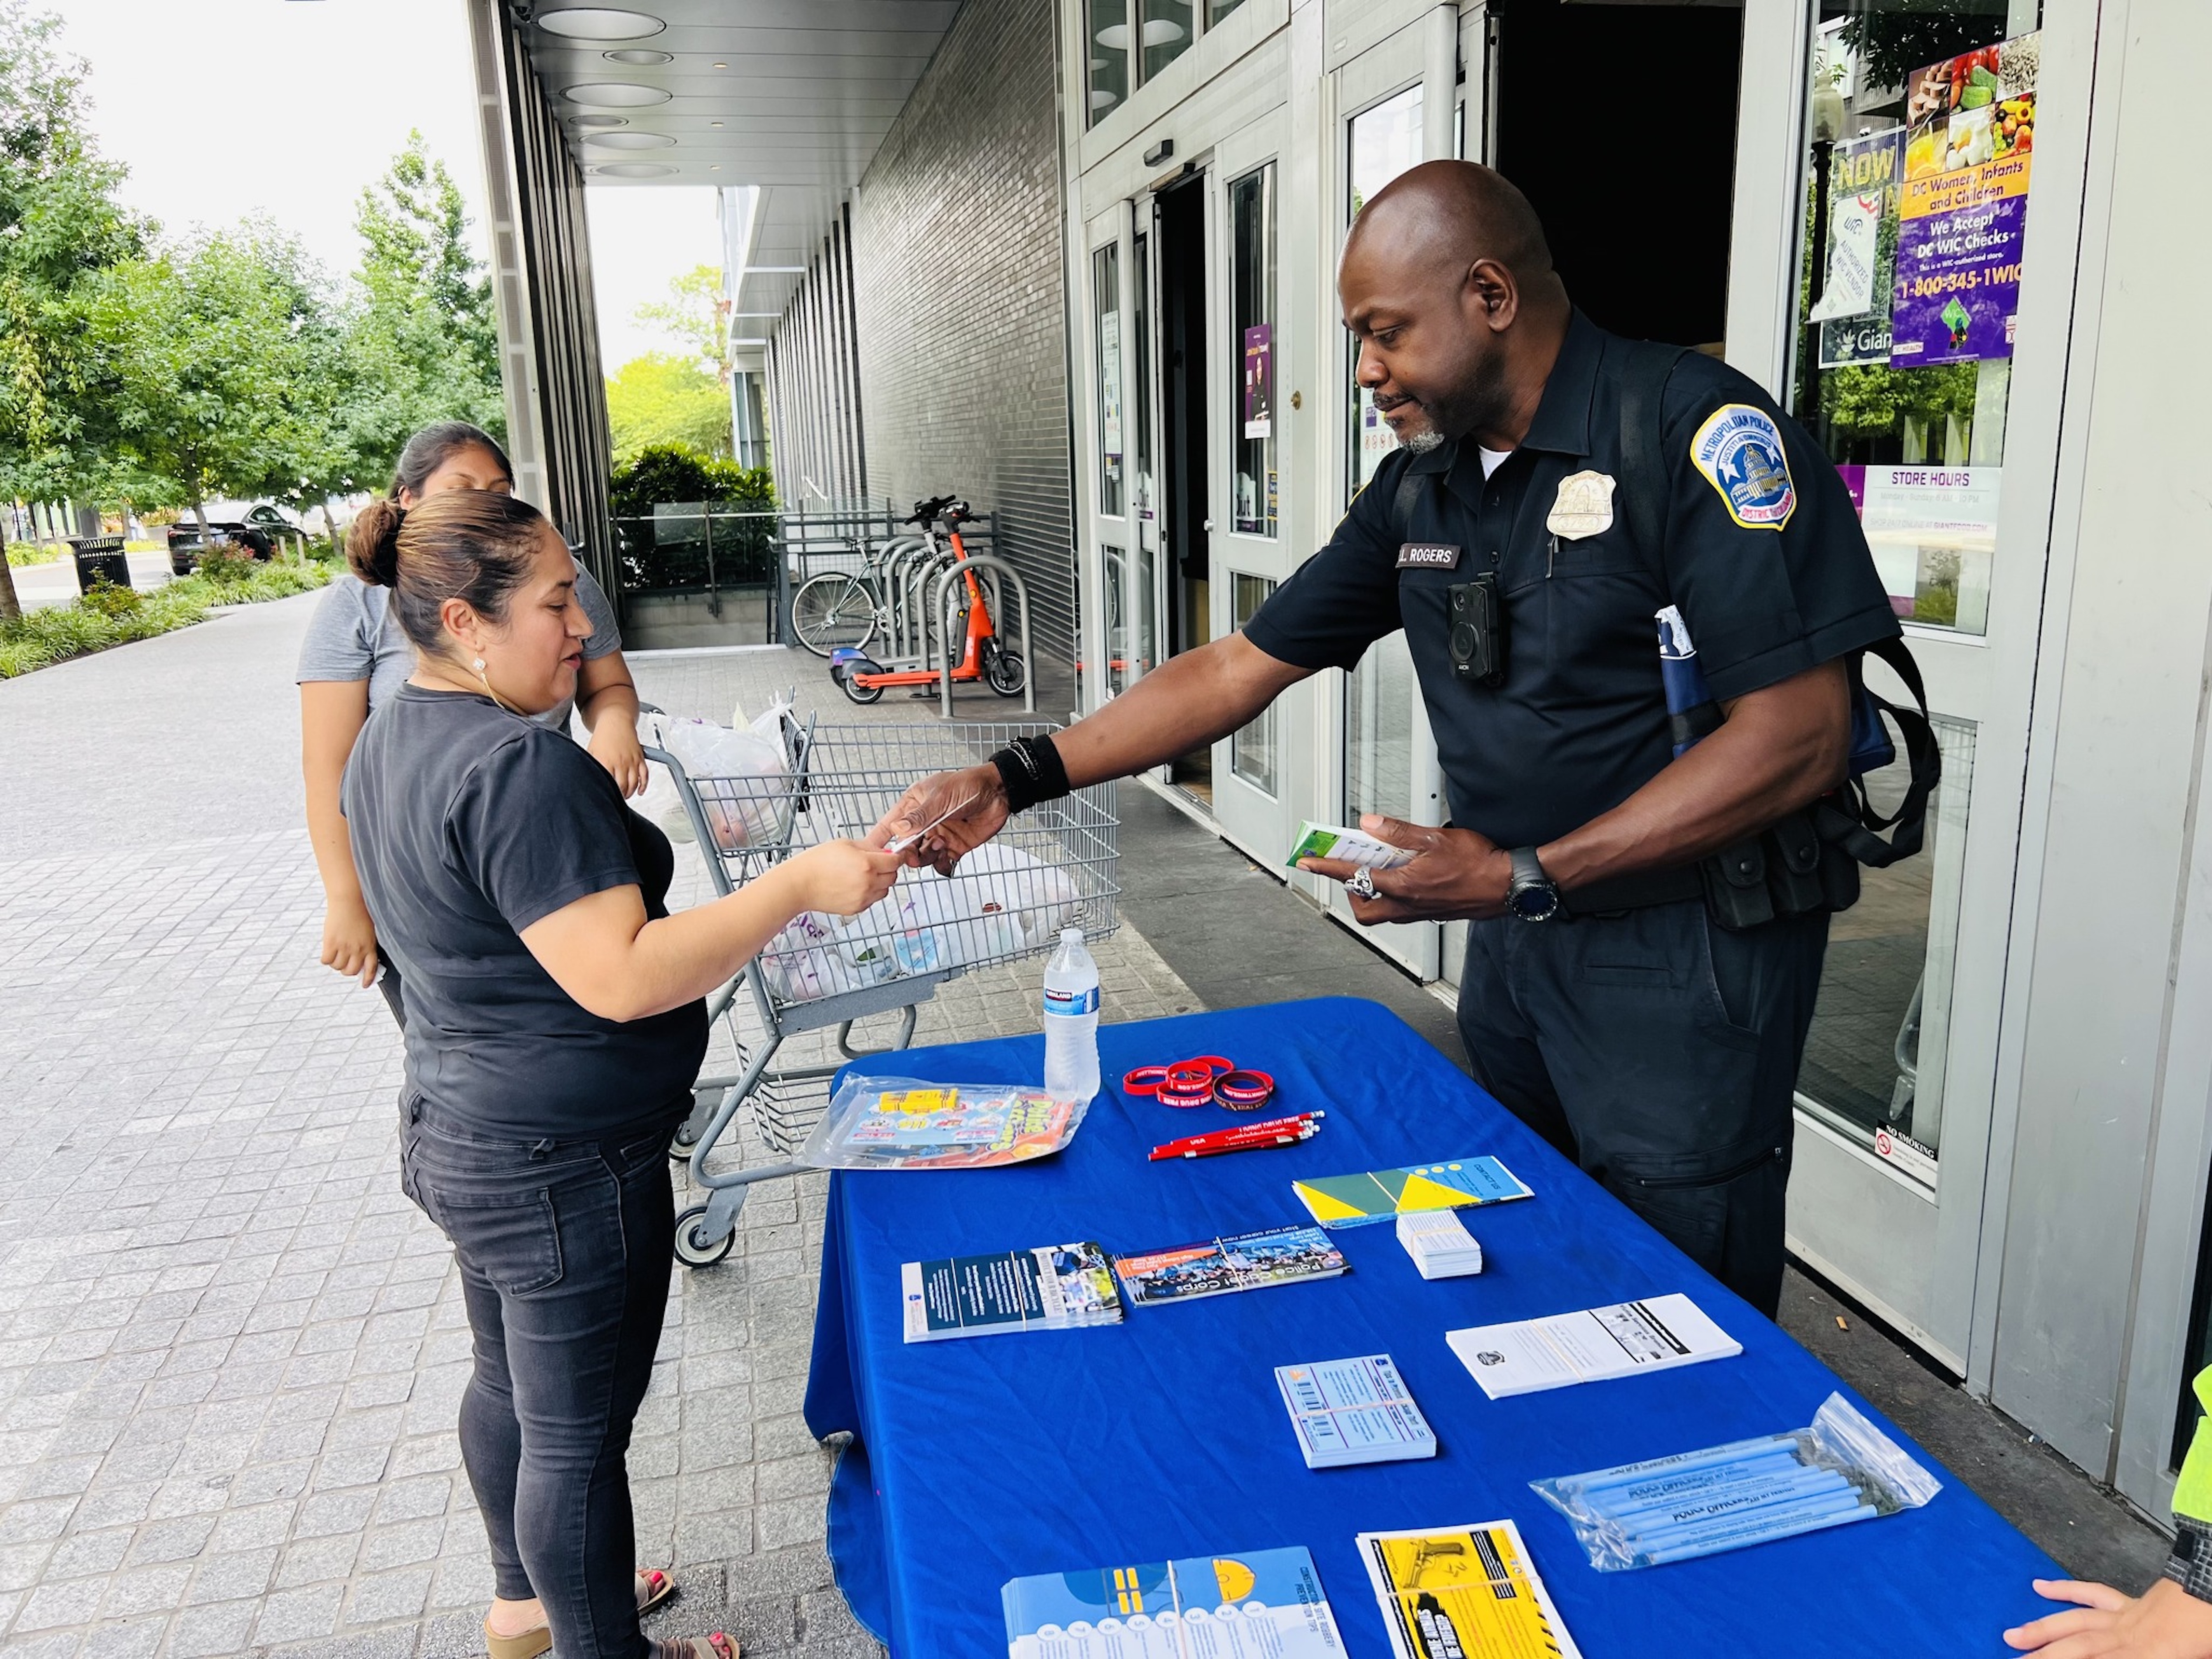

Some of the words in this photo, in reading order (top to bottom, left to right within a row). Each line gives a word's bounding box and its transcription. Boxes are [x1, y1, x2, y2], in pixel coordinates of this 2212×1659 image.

[1838, 145, 1896, 189] NOW
[1913, 183, 1927, 196] DC
[1931, 173, 1976, 192] Women,
[1981, 162, 2023, 180] Infants
[1930, 193, 1950, 210] and
[1955, 185, 2004, 204] Children
[1844, 217, 1863, 234] WIC
[1930, 220, 1949, 236] We
[1953, 212, 1994, 231] Accept
[1917, 243, 1934, 259] DC
[1937, 237, 1962, 255] WIC
[1965, 229, 2009, 250] Checks
[1841, 240, 1868, 284] AUTHORIZED
[1836, 255, 1847, 271] WIC
[1845, 269, 1864, 300] VENDOR
[1857, 329, 1892, 351] Gian
[1701, 414, 1749, 462] METROPOLITAN
[1749, 416, 1775, 436] POLICE
[1892, 472, 1927, 486] STORE
[1930, 473, 1970, 487] HOURS
[1881, 493, 1904, 502] Monday
[1941, 494, 1952, 503] AM
[1968, 495, 1979, 503] PM
[1410, 547, 1452, 563] ROGERS
[1163, 1096, 1179, 1107] FREE
[1180, 1098, 1200, 1107] DRUG
[1886, 1124, 1897, 1137] NO
[1898, 1132, 1934, 1159] SMOKING
[1474, 1164, 1495, 1184] CONTACT
[1493, 1181, 1501, 1190] US
[1275, 1262, 1320, 1275] Police
[1177, 1280, 1221, 1293] Corps
[1300, 1566, 1320, 1606] CONSTRUCTION
[1295, 1583, 1314, 1618] PREVENTION
[1307, 1619, 1319, 1633] TIPS
[1314, 1607, 1326, 1621] SITE
[1319, 1621, 1336, 1648] ROBBERY
